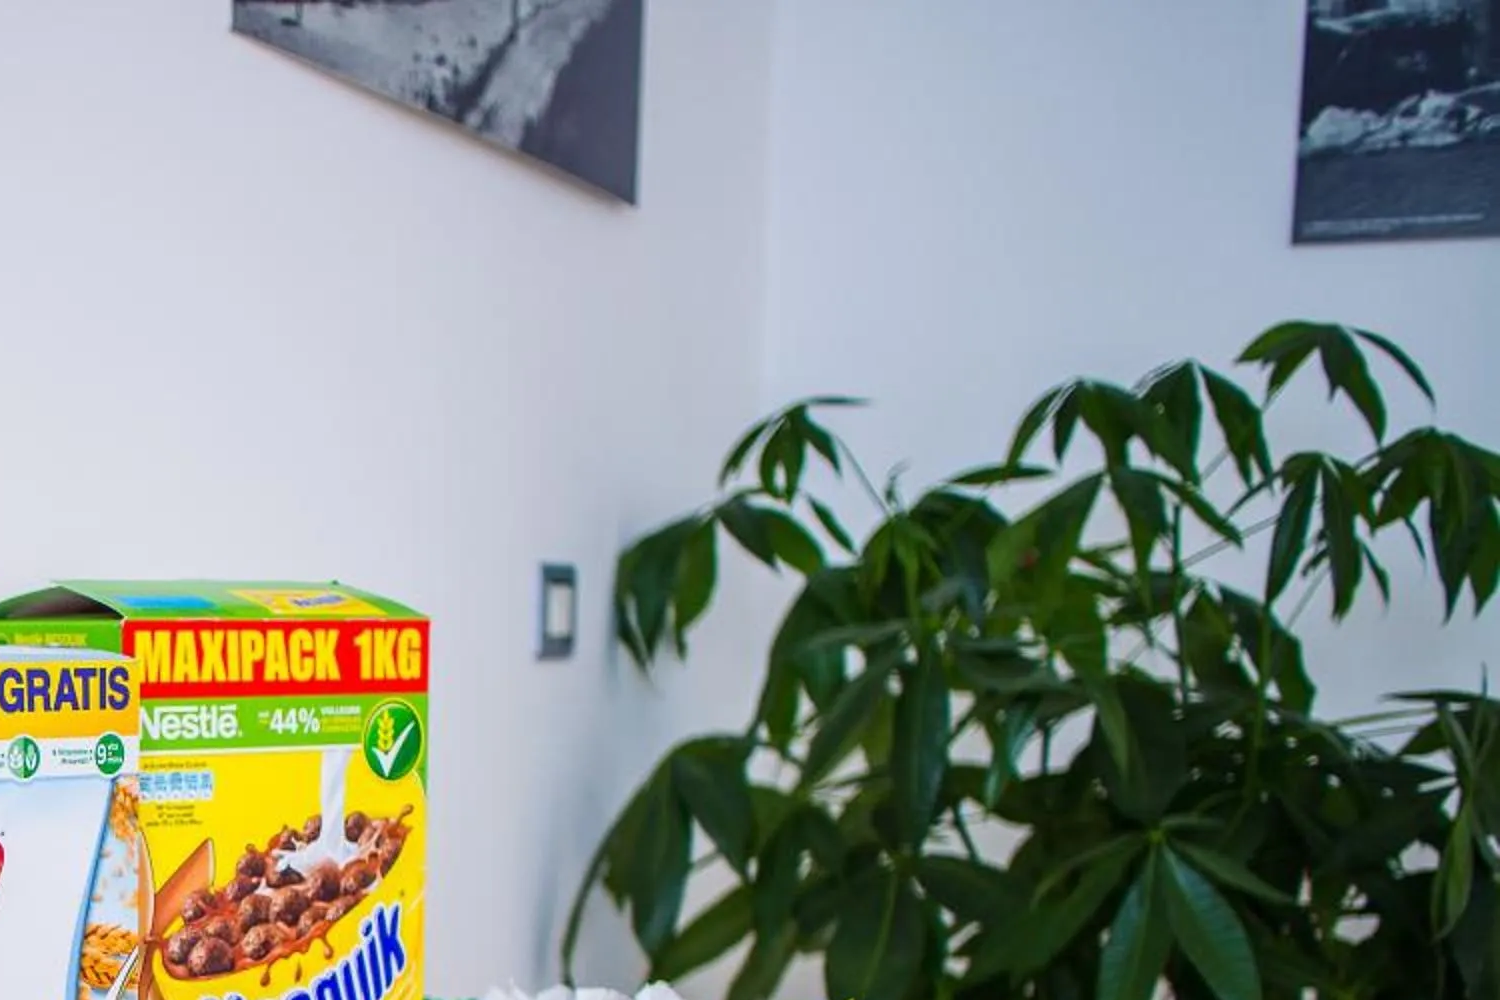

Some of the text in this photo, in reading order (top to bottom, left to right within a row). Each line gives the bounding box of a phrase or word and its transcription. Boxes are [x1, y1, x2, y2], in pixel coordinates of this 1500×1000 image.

[135, 628, 421, 683] MAXIPACK 1KG
[140, 703, 238, 740] Nestlé
